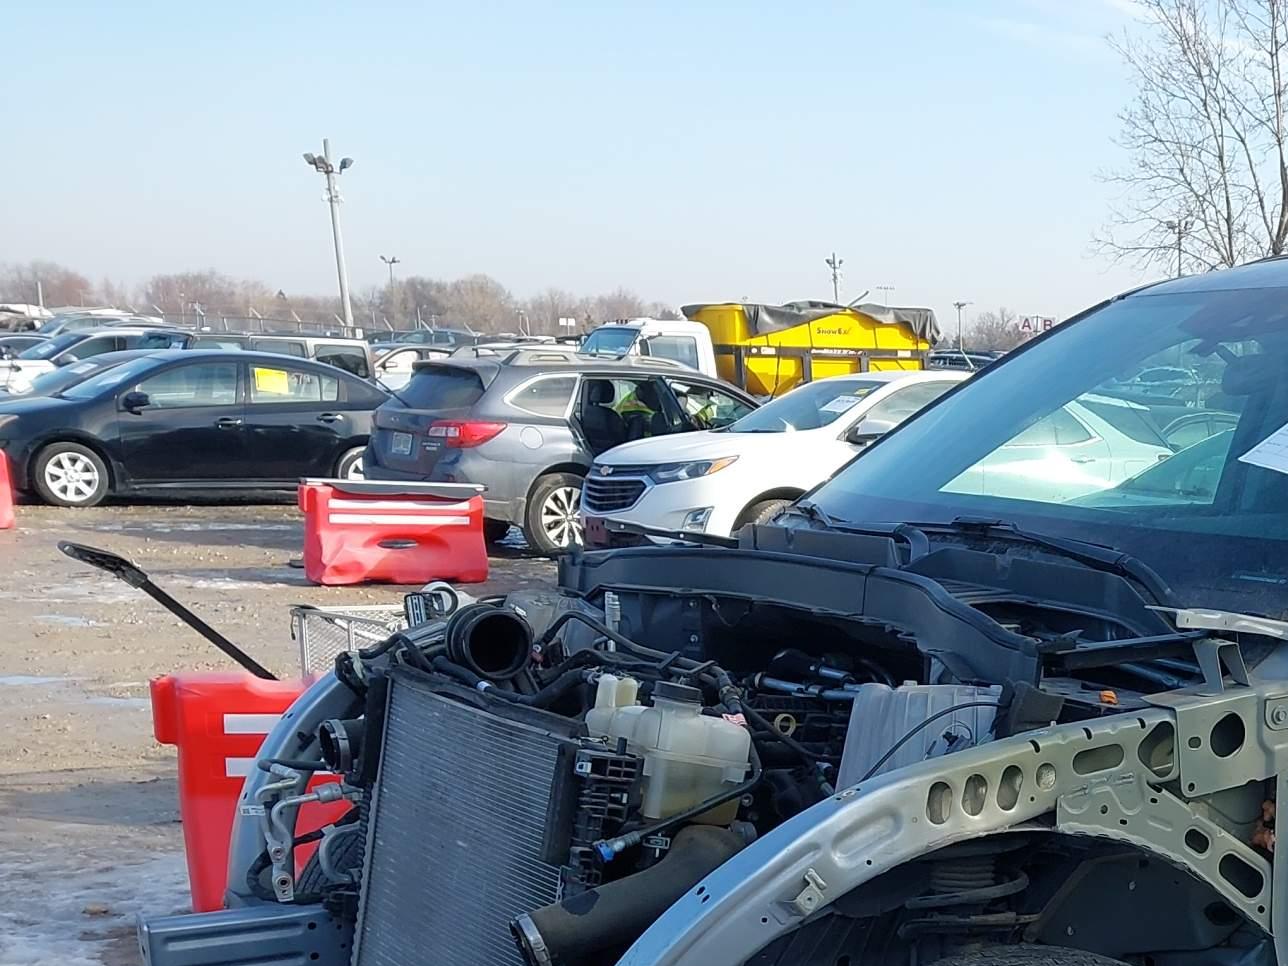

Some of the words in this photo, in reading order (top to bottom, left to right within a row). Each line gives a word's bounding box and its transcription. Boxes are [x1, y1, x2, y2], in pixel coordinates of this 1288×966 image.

[1020, 317, 1032, 330] A
[1043, 319, 1053, 331] B
[816, 327, 850, 335] SnowEx
